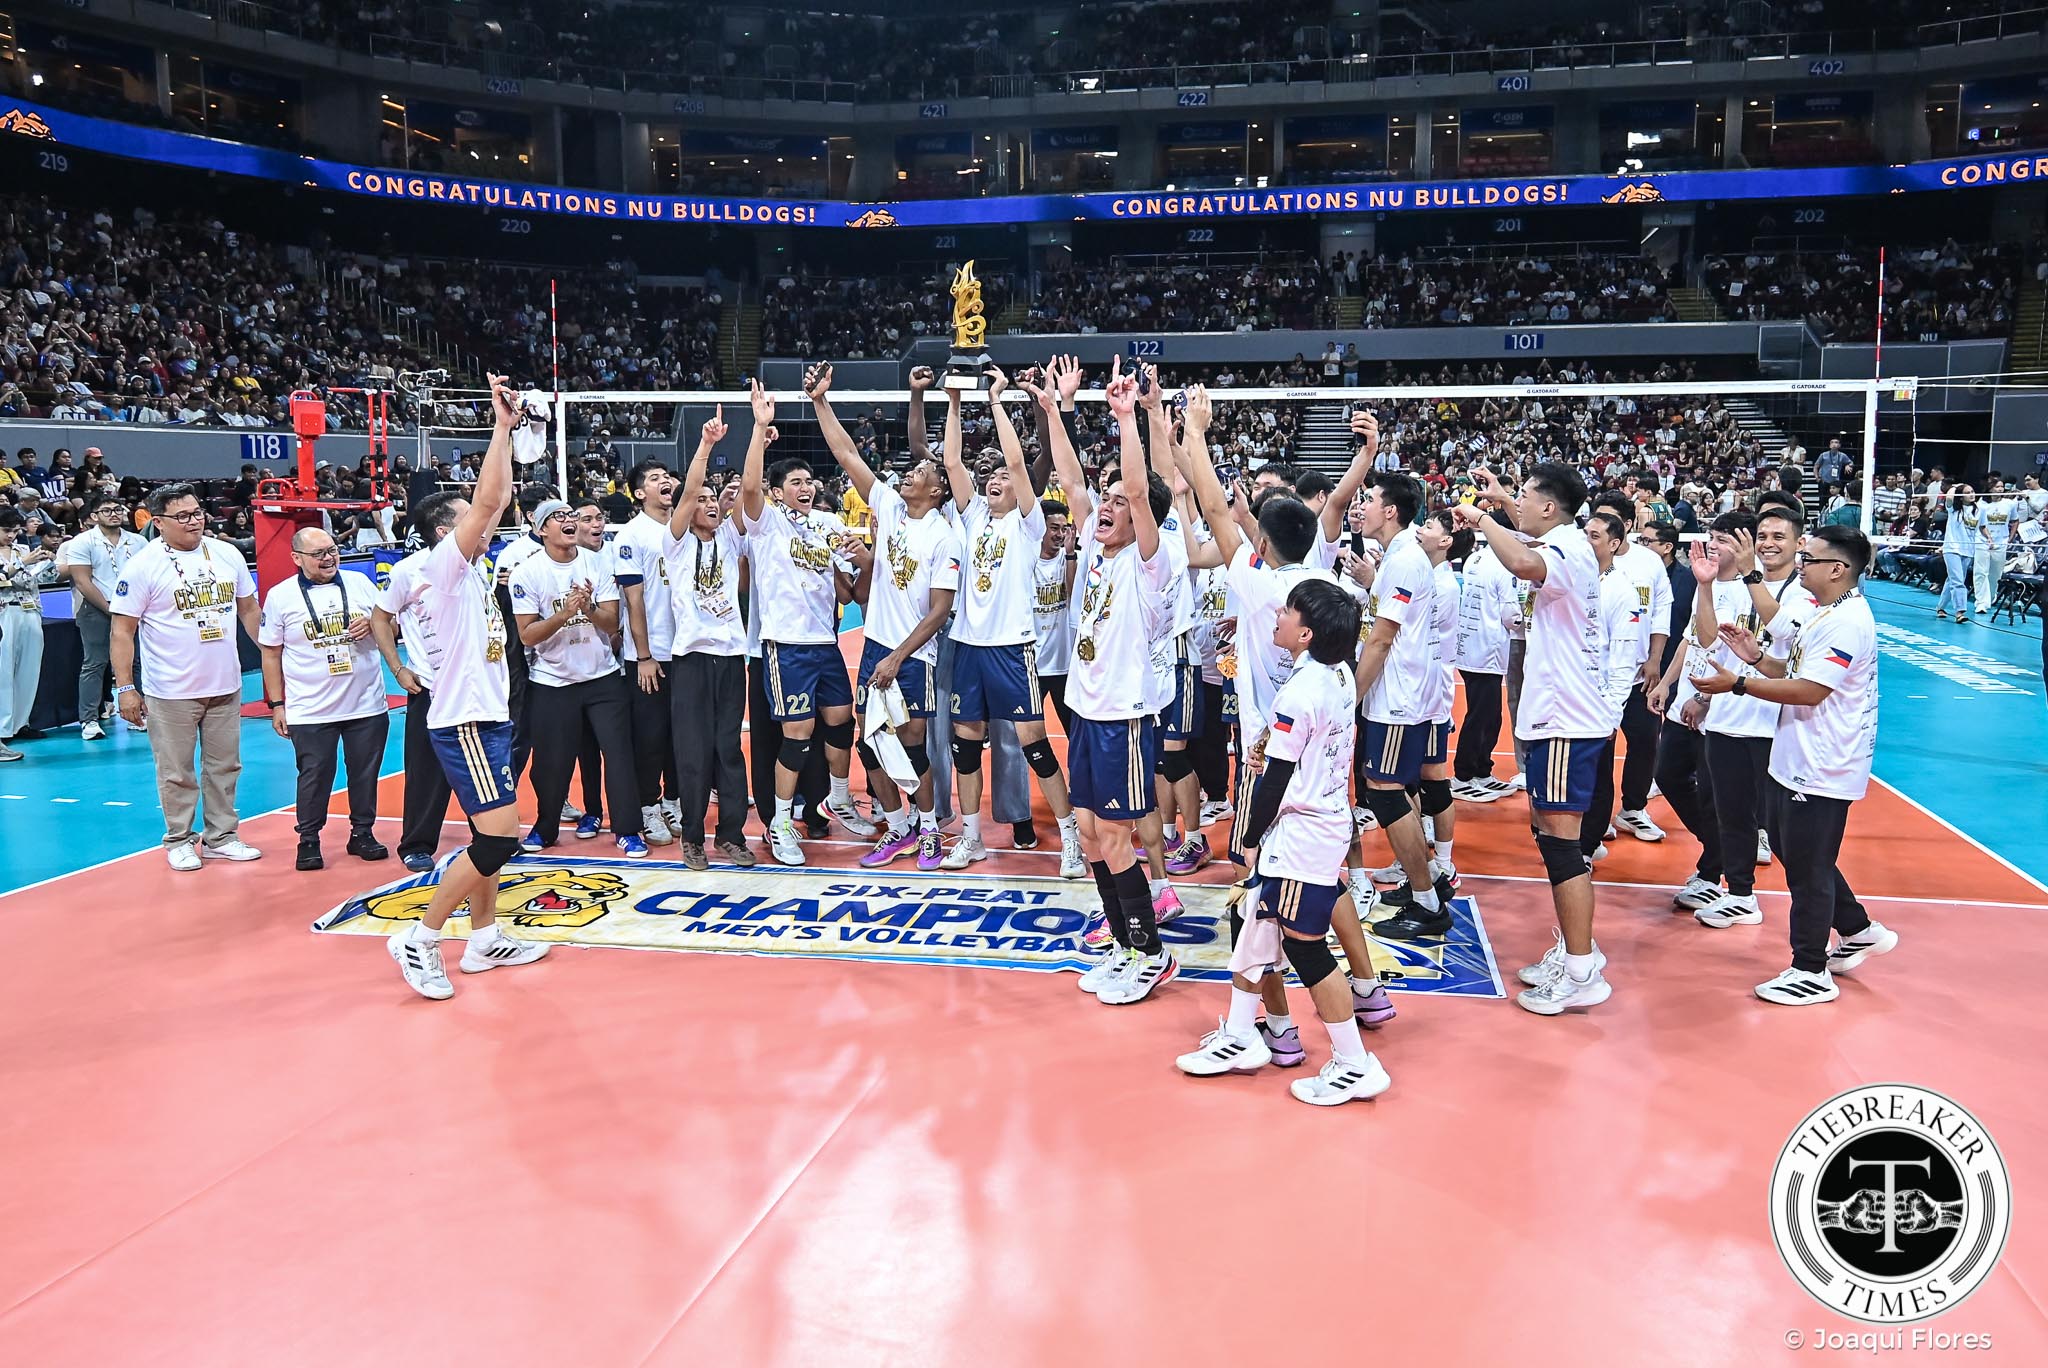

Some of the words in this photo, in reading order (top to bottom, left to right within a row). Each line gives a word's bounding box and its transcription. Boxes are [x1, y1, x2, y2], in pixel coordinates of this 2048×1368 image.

[1810, 60, 1844, 75] 402
[486, 80, 519, 95] 420A
[1501, 76, 1529, 91] 401
[1179, 92, 1207, 107] 422
[922, 104, 945, 117] 421
[40, 152, 68, 172] 219
[1941, 157, 2048, 186] CONGR
[348, 171, 617, 215] CONGRATULATIONS
[629, 201, 662, 217] NU
[673, 203, 815, 223] BULLDOGS!
[1112, 192, 1358, 216] CONGRATULATIONS
[1370, 190, 1403, 207] NU
[1415, 184, 1568, 206] BULLDOGS!
[1794, 209, 1825, 223] 202
[501, 218, 531, 234] 220
[1495, 218, 1521, 232] 201
[936, 236, 957, 249] 221
[1187, 229, 1214, 242] 222
[1601, 284, 1616, 296] NU
[1512, 334, 1538, 350] 101
[1919, 332, 1938, 343] NU
[1133, 341, 1159, 355] 122
[248, 434, 281, 459] 118
[1468, 435, 1488, 452] NU
[41, 479, 65, 498] NU
[786, 694, 811, 715] 22
[1222, 693, 1240, 715] 23
[501, 766, 515, 792] 3
[820, 884, 1062, 905] SIX-PEAT
[633, 890, 1220, 945] CHAMPIOS
[682, 921, 827, 940] MEN'S
[839, 925, 1107, 956] VOLLEYBA
